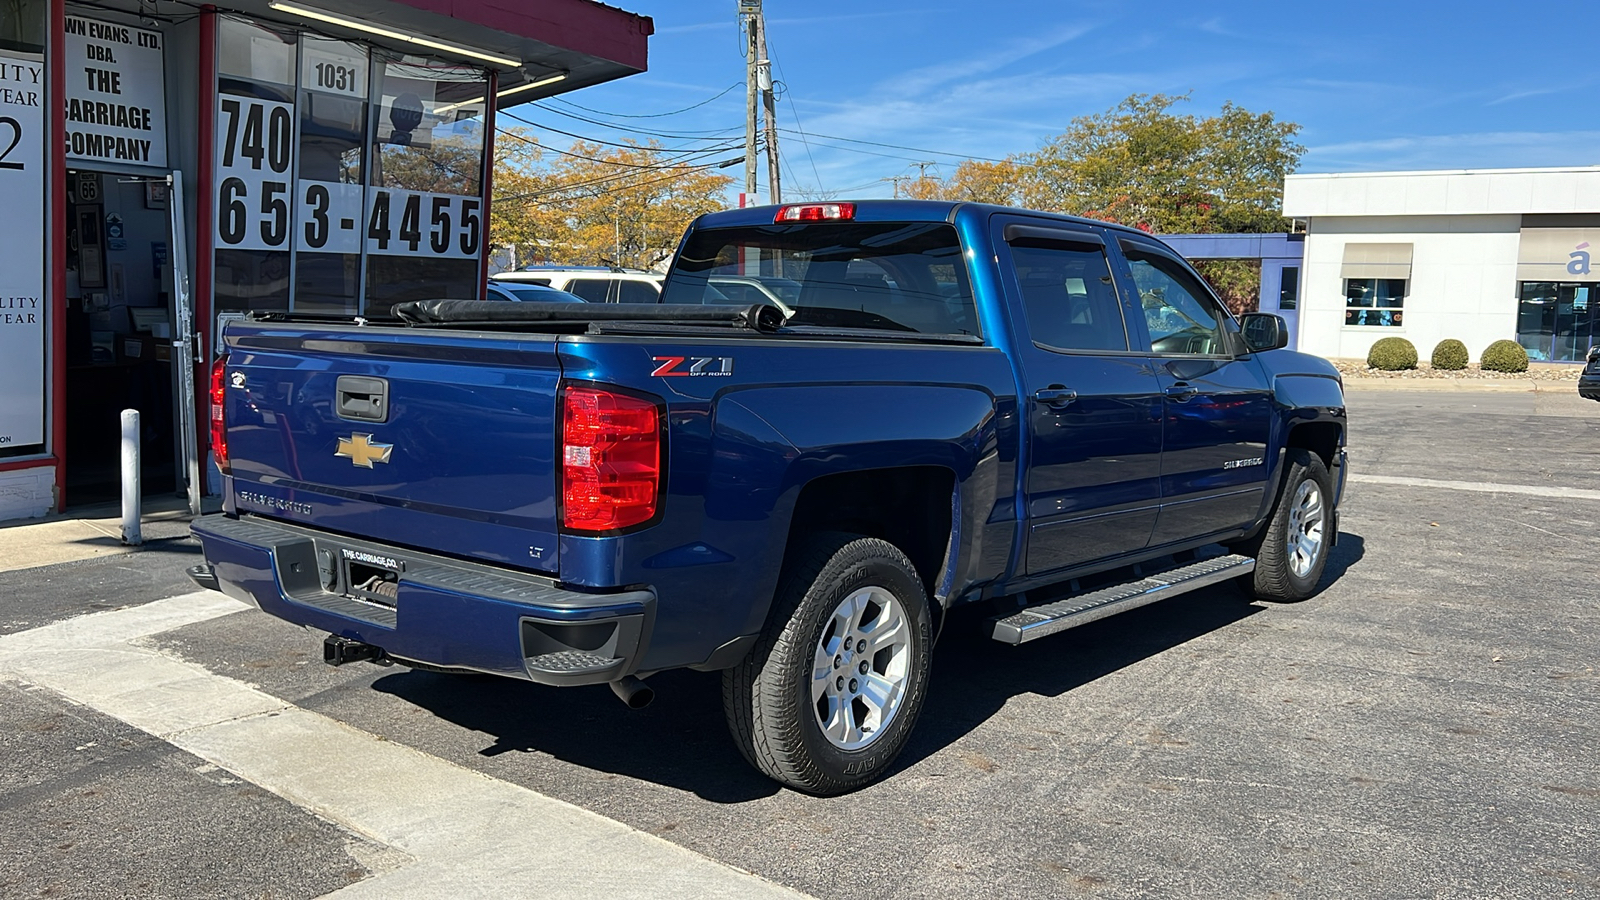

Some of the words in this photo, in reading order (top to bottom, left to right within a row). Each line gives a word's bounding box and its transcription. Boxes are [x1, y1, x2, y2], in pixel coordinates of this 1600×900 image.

[89, 22, 132, 45] EVANS.
[137, 31, 161, 50] LTD.
[86, 44, 116, 64] DBA.
[84, 67, 121, 94] THE
[316, 62, 355, 92] 1031
[0, 88, 38, 107] EAR
[221, 99, 291, 173] 740
[82, 182, 95, 198] 66
[0, 313, 36, 324] EAR
[651, 356, 732, 376] Z71
[241, 491, 313, 515] SILVERADO
[342, 549, 355, 559] THE
